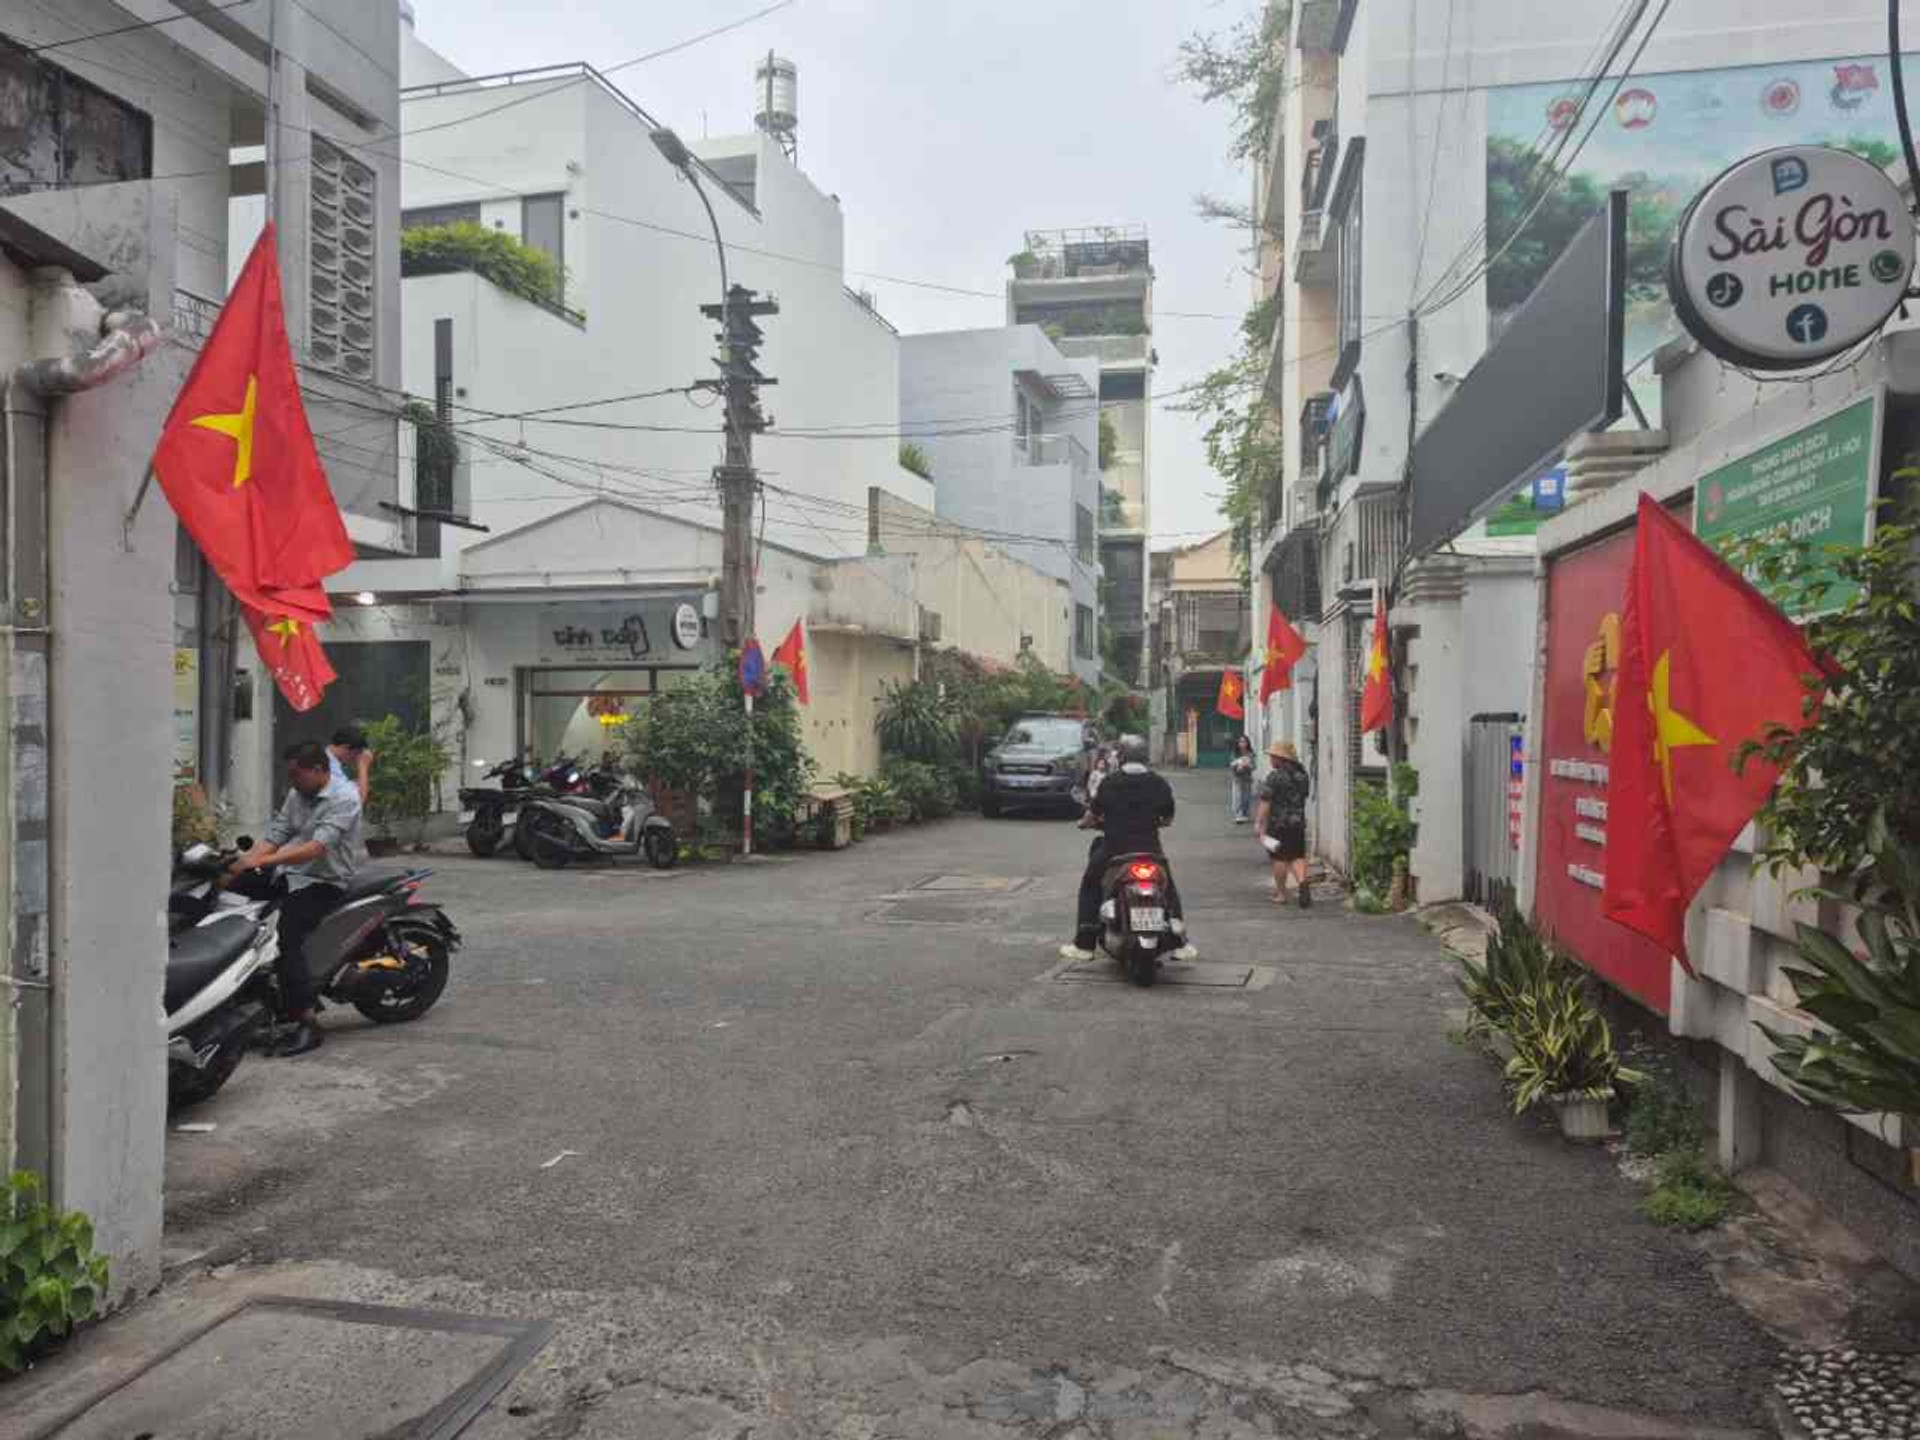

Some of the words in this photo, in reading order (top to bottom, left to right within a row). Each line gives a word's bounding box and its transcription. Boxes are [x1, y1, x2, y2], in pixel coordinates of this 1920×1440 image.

[1708, 205, 1789, 261] Sài
[1795, 193, 1892, 267] Gòn
[1769, 265, 1860, 297] HOME
